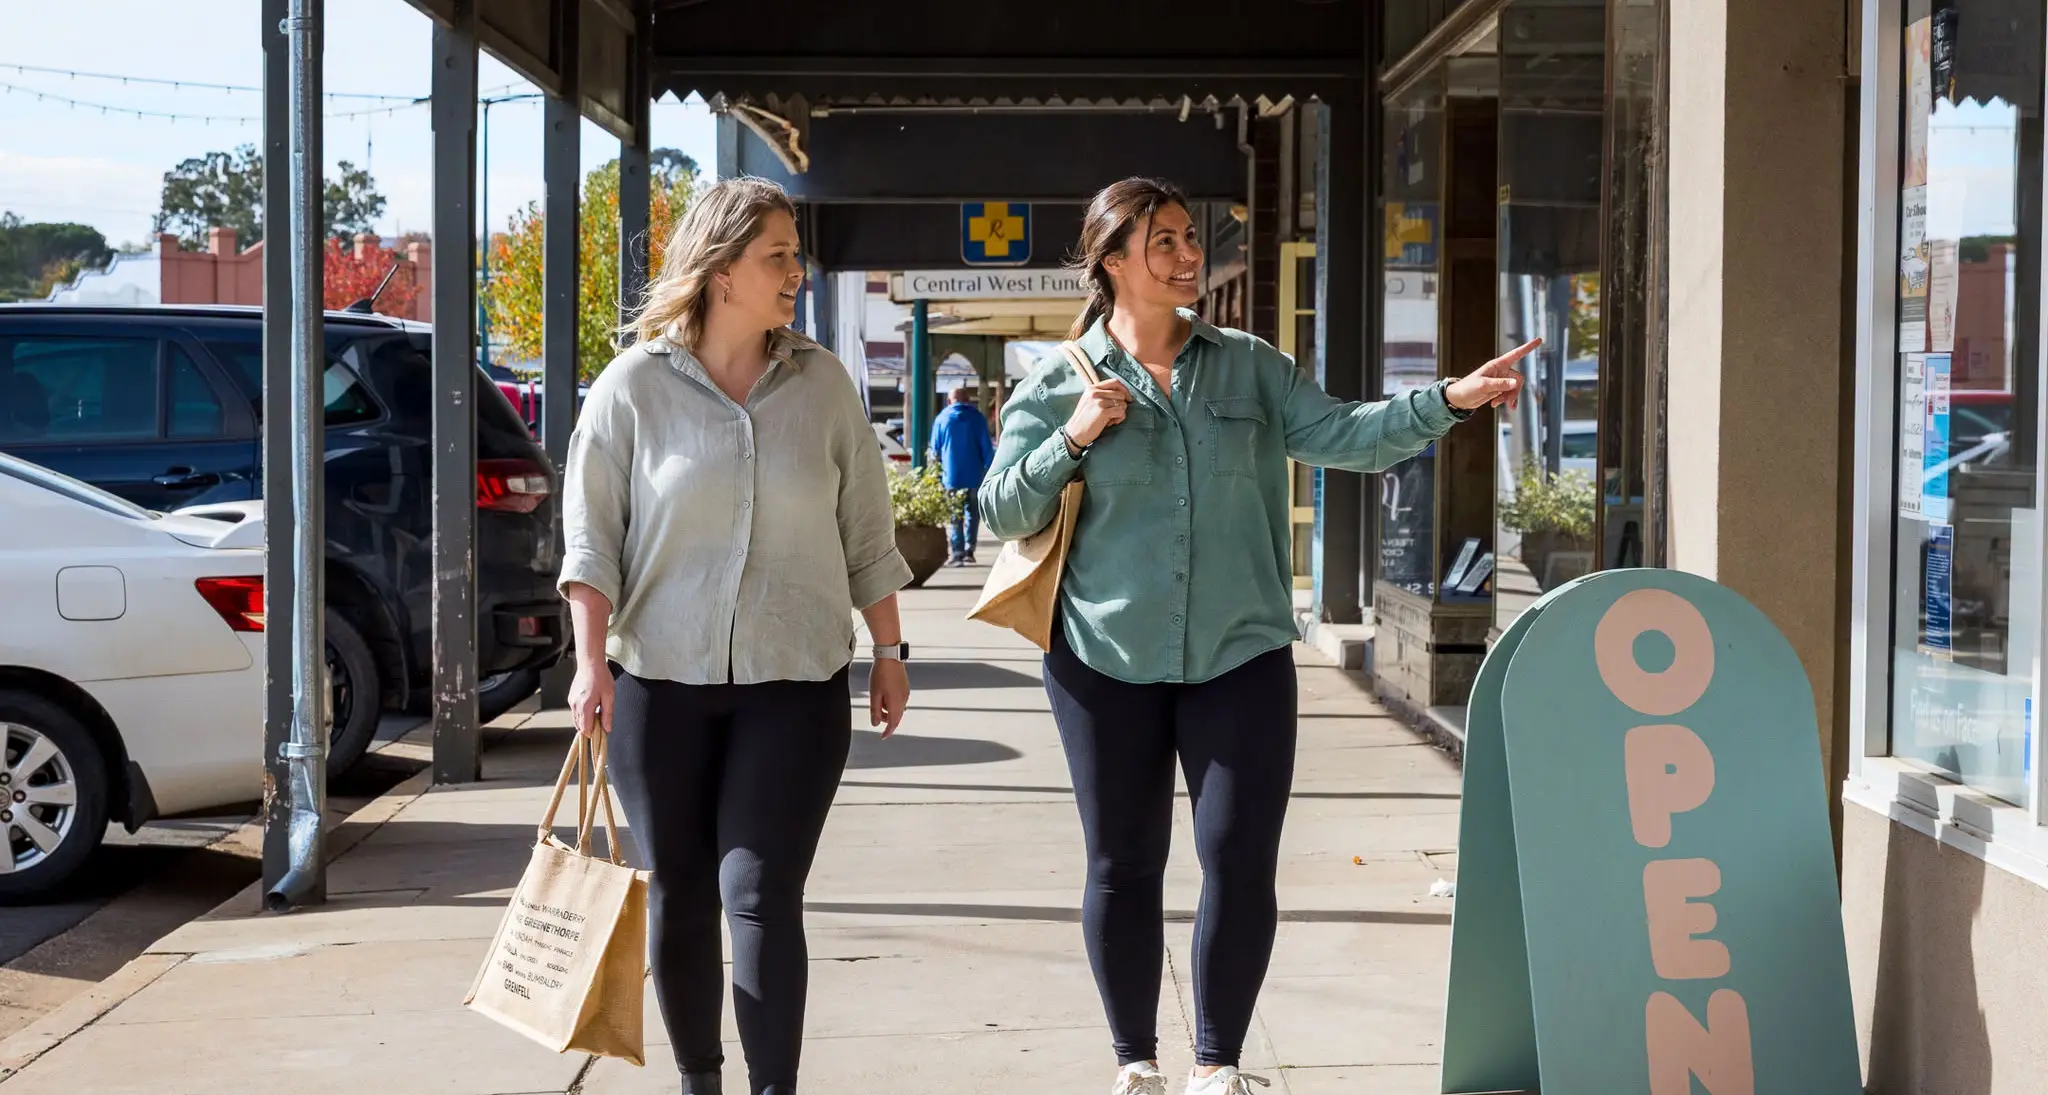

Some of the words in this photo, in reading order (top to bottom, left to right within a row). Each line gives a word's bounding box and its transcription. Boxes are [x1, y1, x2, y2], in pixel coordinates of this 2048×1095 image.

[913, 276, 982, 293] Central
[988, 275, 1033, 292] West
[1594, 589, 1755, 1095] OPEN
[541, 904, 587, 924] WARRADERRY
[524, 916, 580, 942] GREENETHORPE
[504, 978, 531, 1000] GRENFELL
